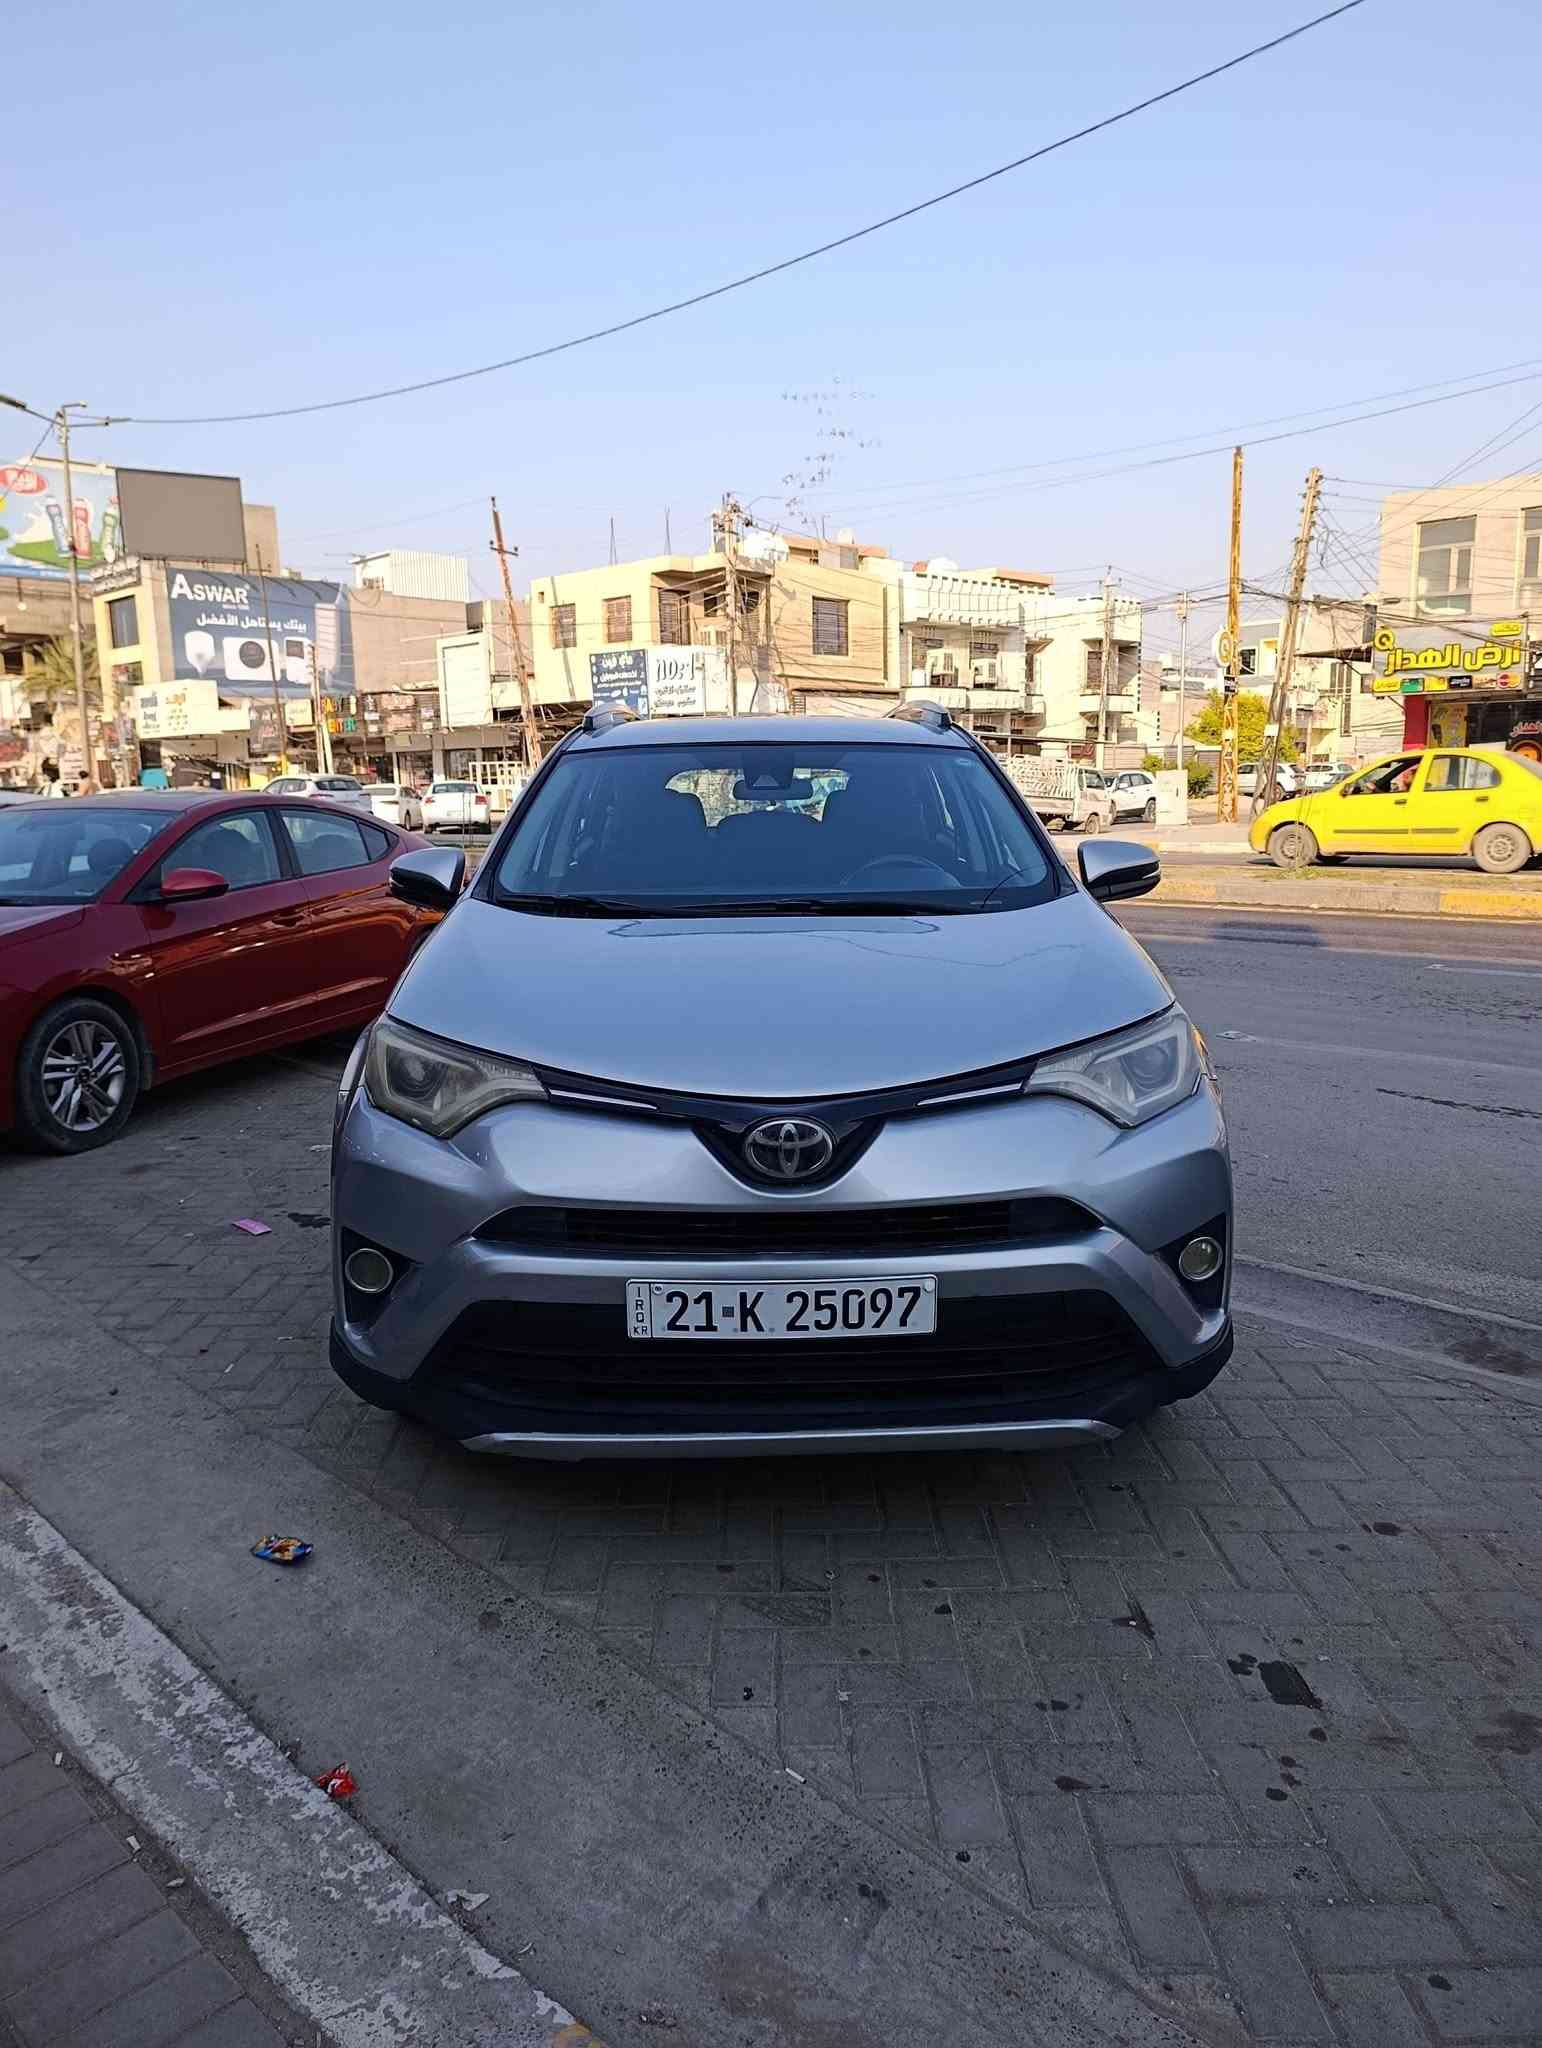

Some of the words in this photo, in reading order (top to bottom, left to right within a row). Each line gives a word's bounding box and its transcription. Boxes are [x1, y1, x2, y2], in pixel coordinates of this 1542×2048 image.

[171, 573, 249, 604] ASWAR
[283, 618, 307, 633] بيتك
[665, 1290, 718, 1333] 21
[739, 1291, 765, 1333] K
[785, 1286, 921, 1332] 25097
